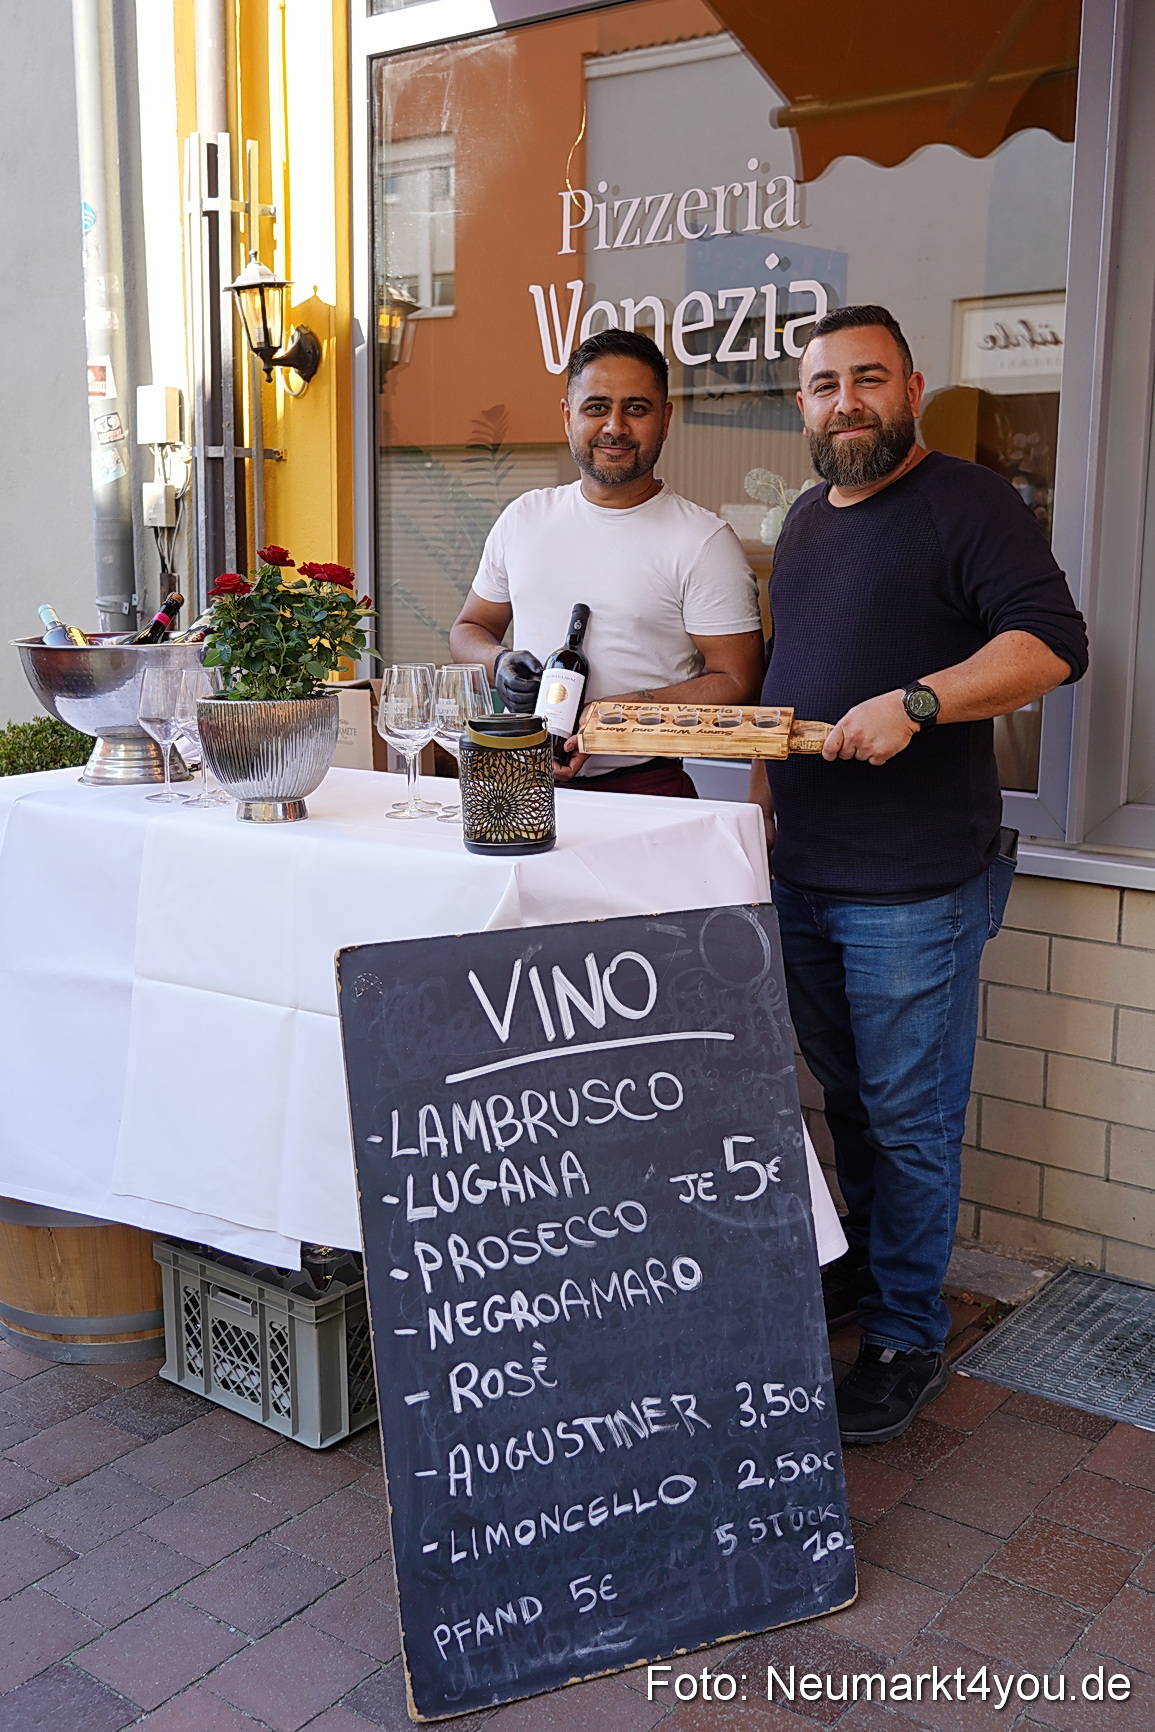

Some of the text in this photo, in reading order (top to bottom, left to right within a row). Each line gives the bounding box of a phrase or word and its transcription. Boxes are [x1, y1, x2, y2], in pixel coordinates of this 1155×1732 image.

[557, 157, 801, 255] Pizzeria
[612, 703, 734, 714] Pizzeria Venezia
[468, 951, 658, 1043] VINO
[669, 1171, 718, 1204] JE
[713, 1503, 840, 1557] 5 STÜCK
[433, 1573, 619, 1662] PFAND 5€
